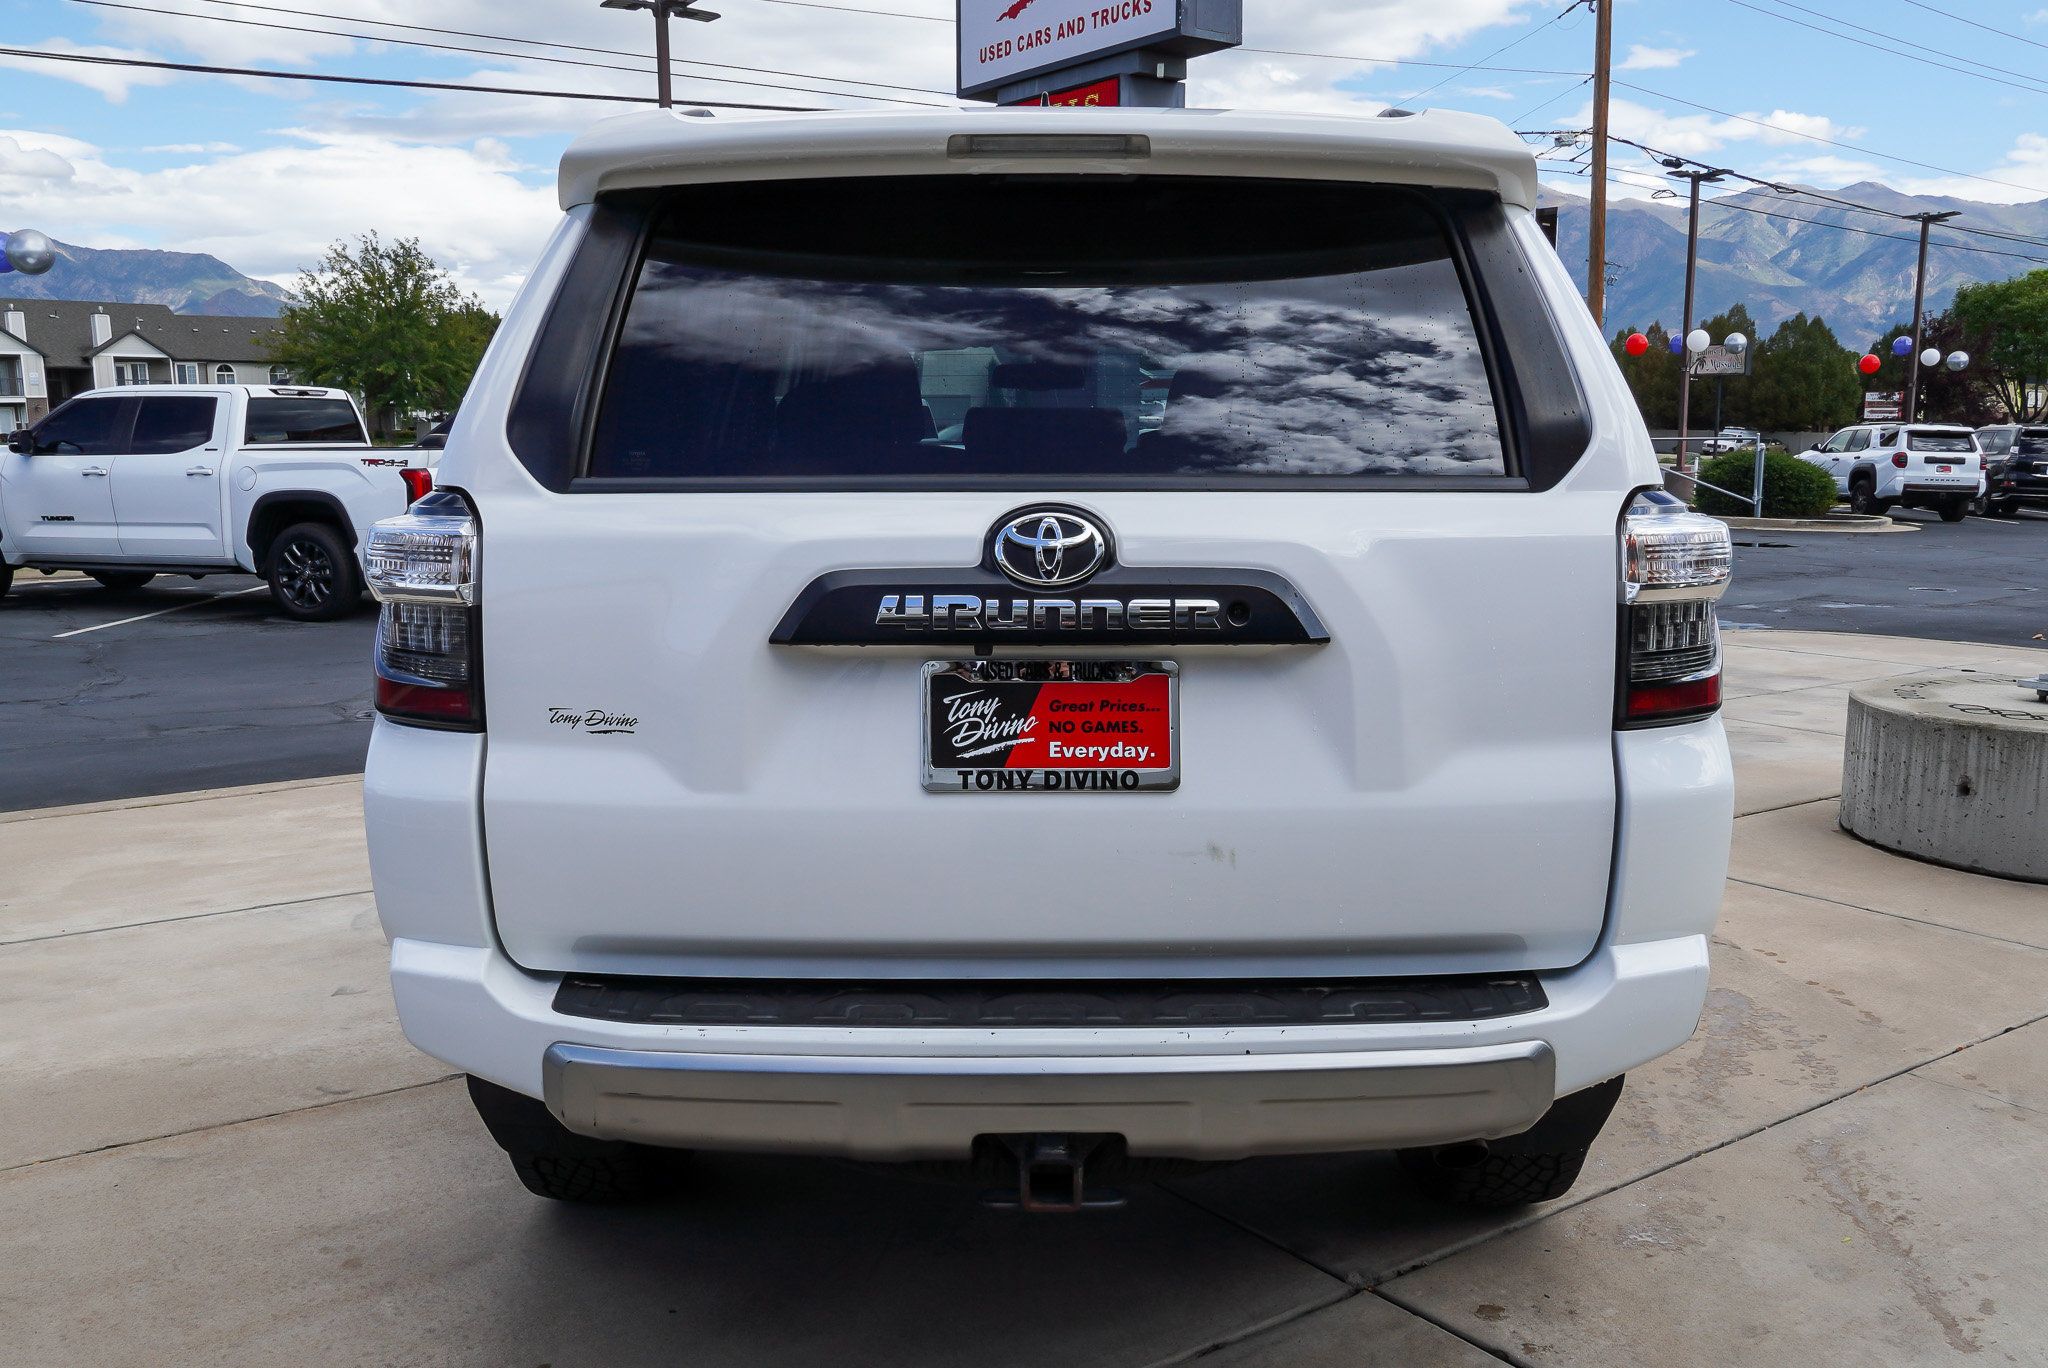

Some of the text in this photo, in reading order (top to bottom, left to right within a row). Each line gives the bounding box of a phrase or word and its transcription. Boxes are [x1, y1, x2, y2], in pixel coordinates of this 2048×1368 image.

[979, 0, 1152, 64] USED CARS AND TRUCKS
[1054, 661, 1064, 681] &
[942, 689, 1002, 723] Tony
[1049, 699, 1095, 713] Great
[548, 707, 639, 730] Tony Divino
[1049, 720, 1144, 734] NO GAMES.
[942, 713, 1039, 748] Divino
[1049, 741, 1156, 762] Everyday.
[957, 770, 1140, 790] TONY DIVINO
